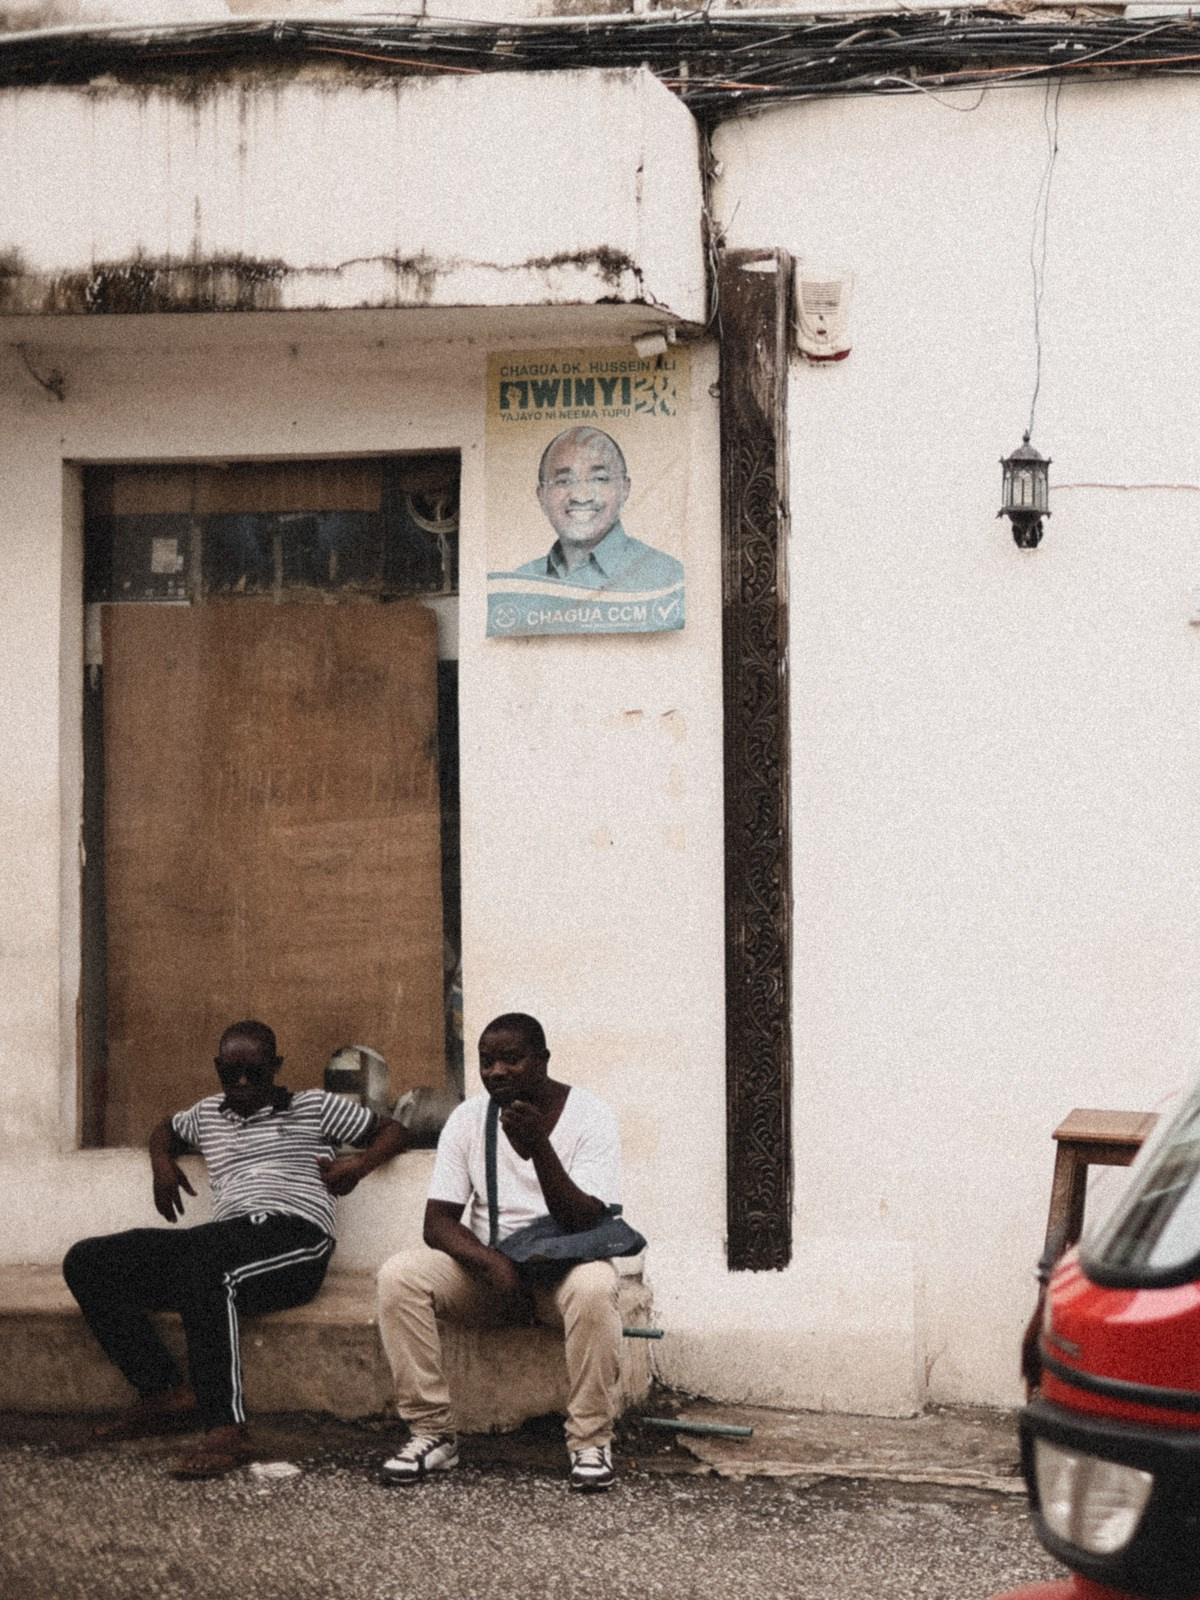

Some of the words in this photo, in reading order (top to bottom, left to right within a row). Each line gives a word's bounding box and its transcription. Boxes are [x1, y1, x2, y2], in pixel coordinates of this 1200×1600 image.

[499, 363, 559, 377] CHAGUA
[589, 360, 651, 373] HUSSEIN
[500, 411, 542, 422] YAJAYO
[545, 410, 556, 419] NI
[558, 409, 599, 420] NEEMA
[601, 408, 631, 418] TUPU
[526, 607, 603, 626] CHAGUA
[607, 606, 648, 622] CCM
